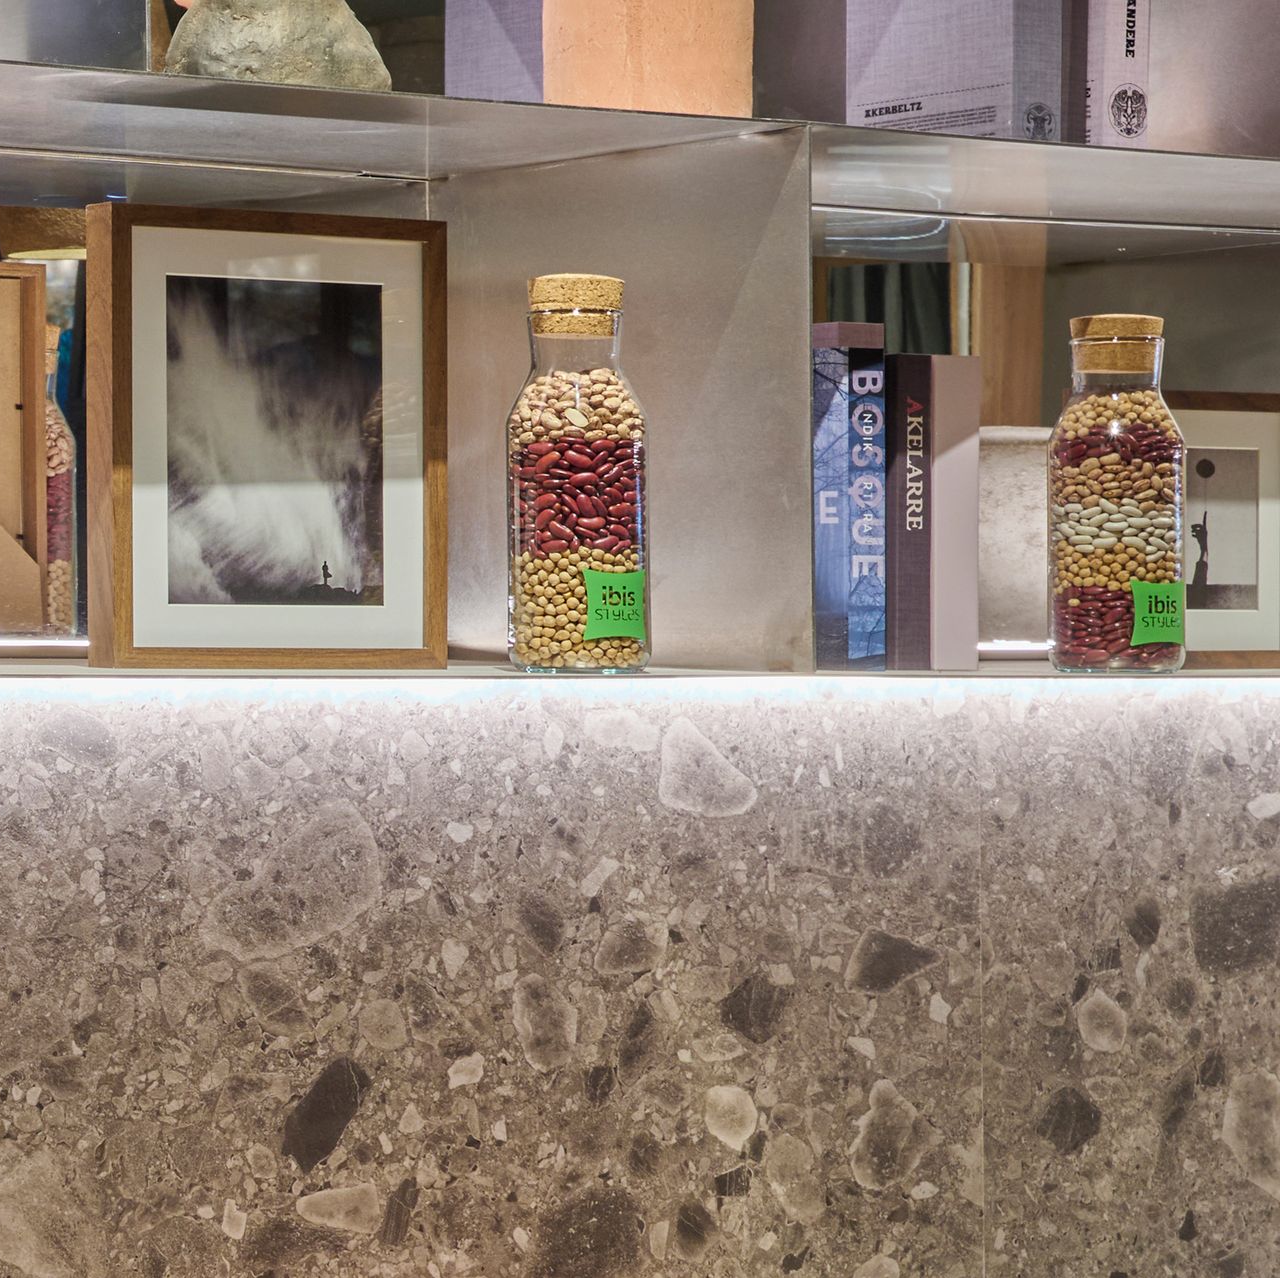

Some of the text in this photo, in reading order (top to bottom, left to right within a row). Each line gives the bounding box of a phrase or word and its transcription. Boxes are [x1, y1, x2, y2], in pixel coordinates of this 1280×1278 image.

[864, 102, 923, 118] AKERBELTZ
[848, 370, 884, 578] BOSQUE
[906, 396, 924, 532] AKELARRE
[602, 585, 636, 607] ibis
[1148, 595, 1177, 614] ibis
